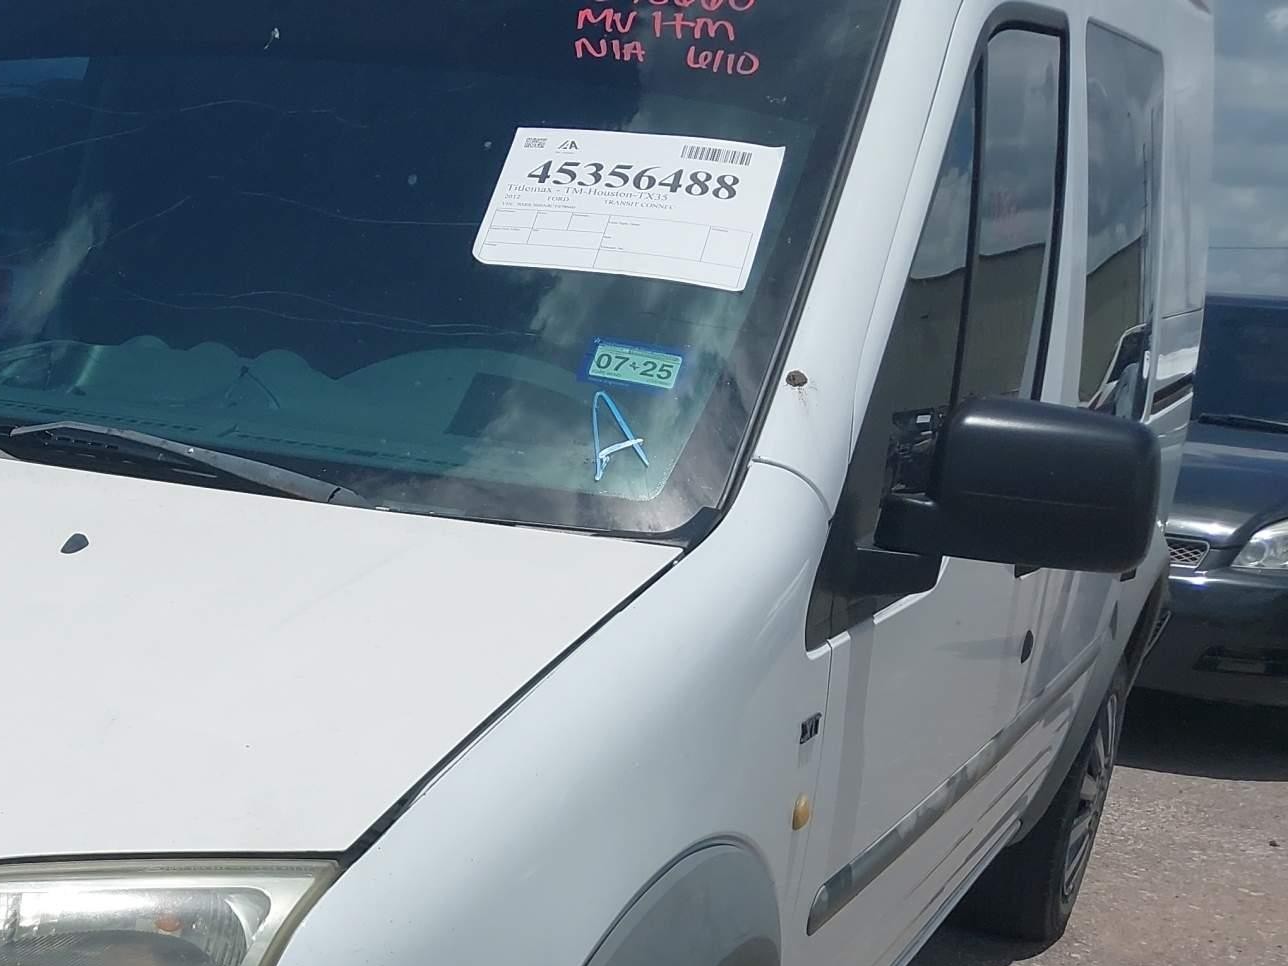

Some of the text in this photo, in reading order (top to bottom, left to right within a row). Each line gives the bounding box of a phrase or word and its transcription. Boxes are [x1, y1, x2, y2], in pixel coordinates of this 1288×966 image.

[527, 160, 740, 200] 45356488
[595, 353, 630, 371] 07
[639, 360, 674, 380] 25
